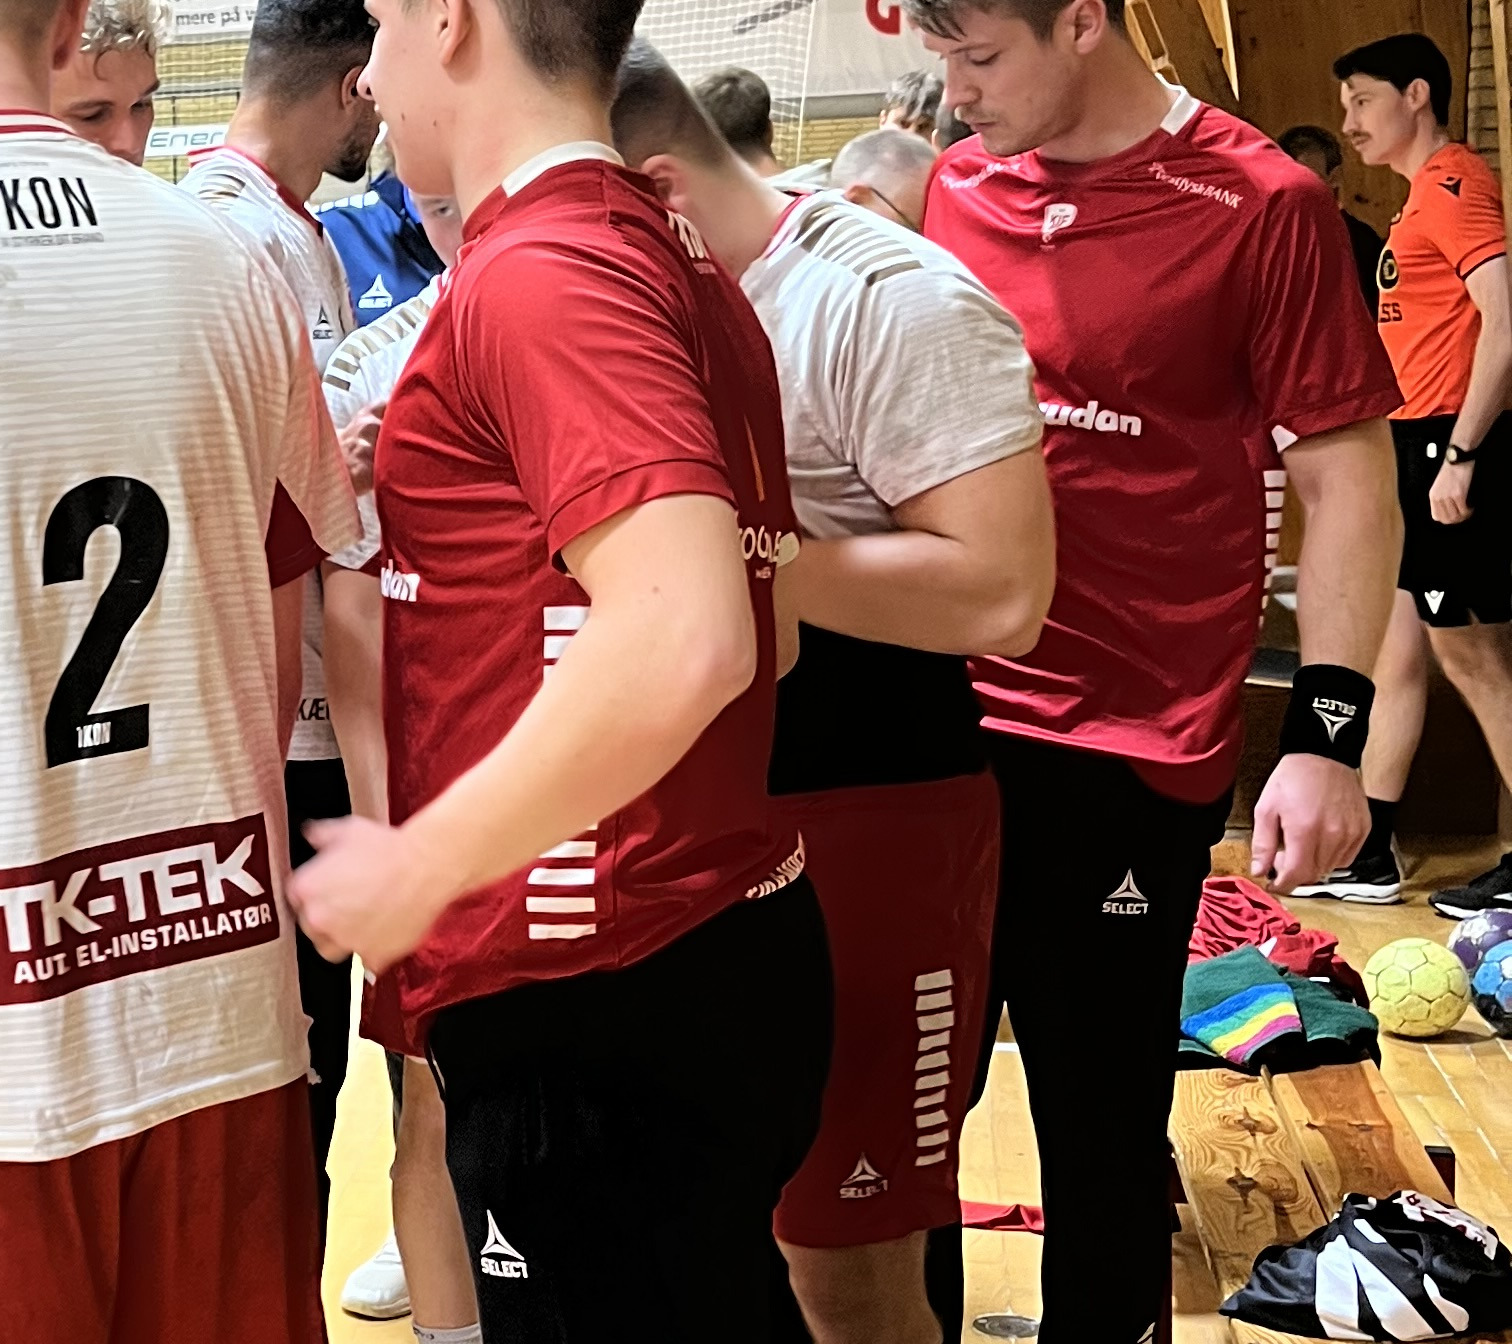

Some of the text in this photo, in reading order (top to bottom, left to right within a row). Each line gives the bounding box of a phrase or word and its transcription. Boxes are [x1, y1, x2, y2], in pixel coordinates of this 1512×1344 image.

[175, 11, 216, 26] mere
[149, 130, 224, 148] Ener
[1038, 400, 1142, 436] udan
[42, 475, 170, 769] 2
[1101, 901, 1149, 915] SELECT
[75, 902, 272, 968] EL-INSTALLATØR
[480, 1256, 529, 1279] SELECT
